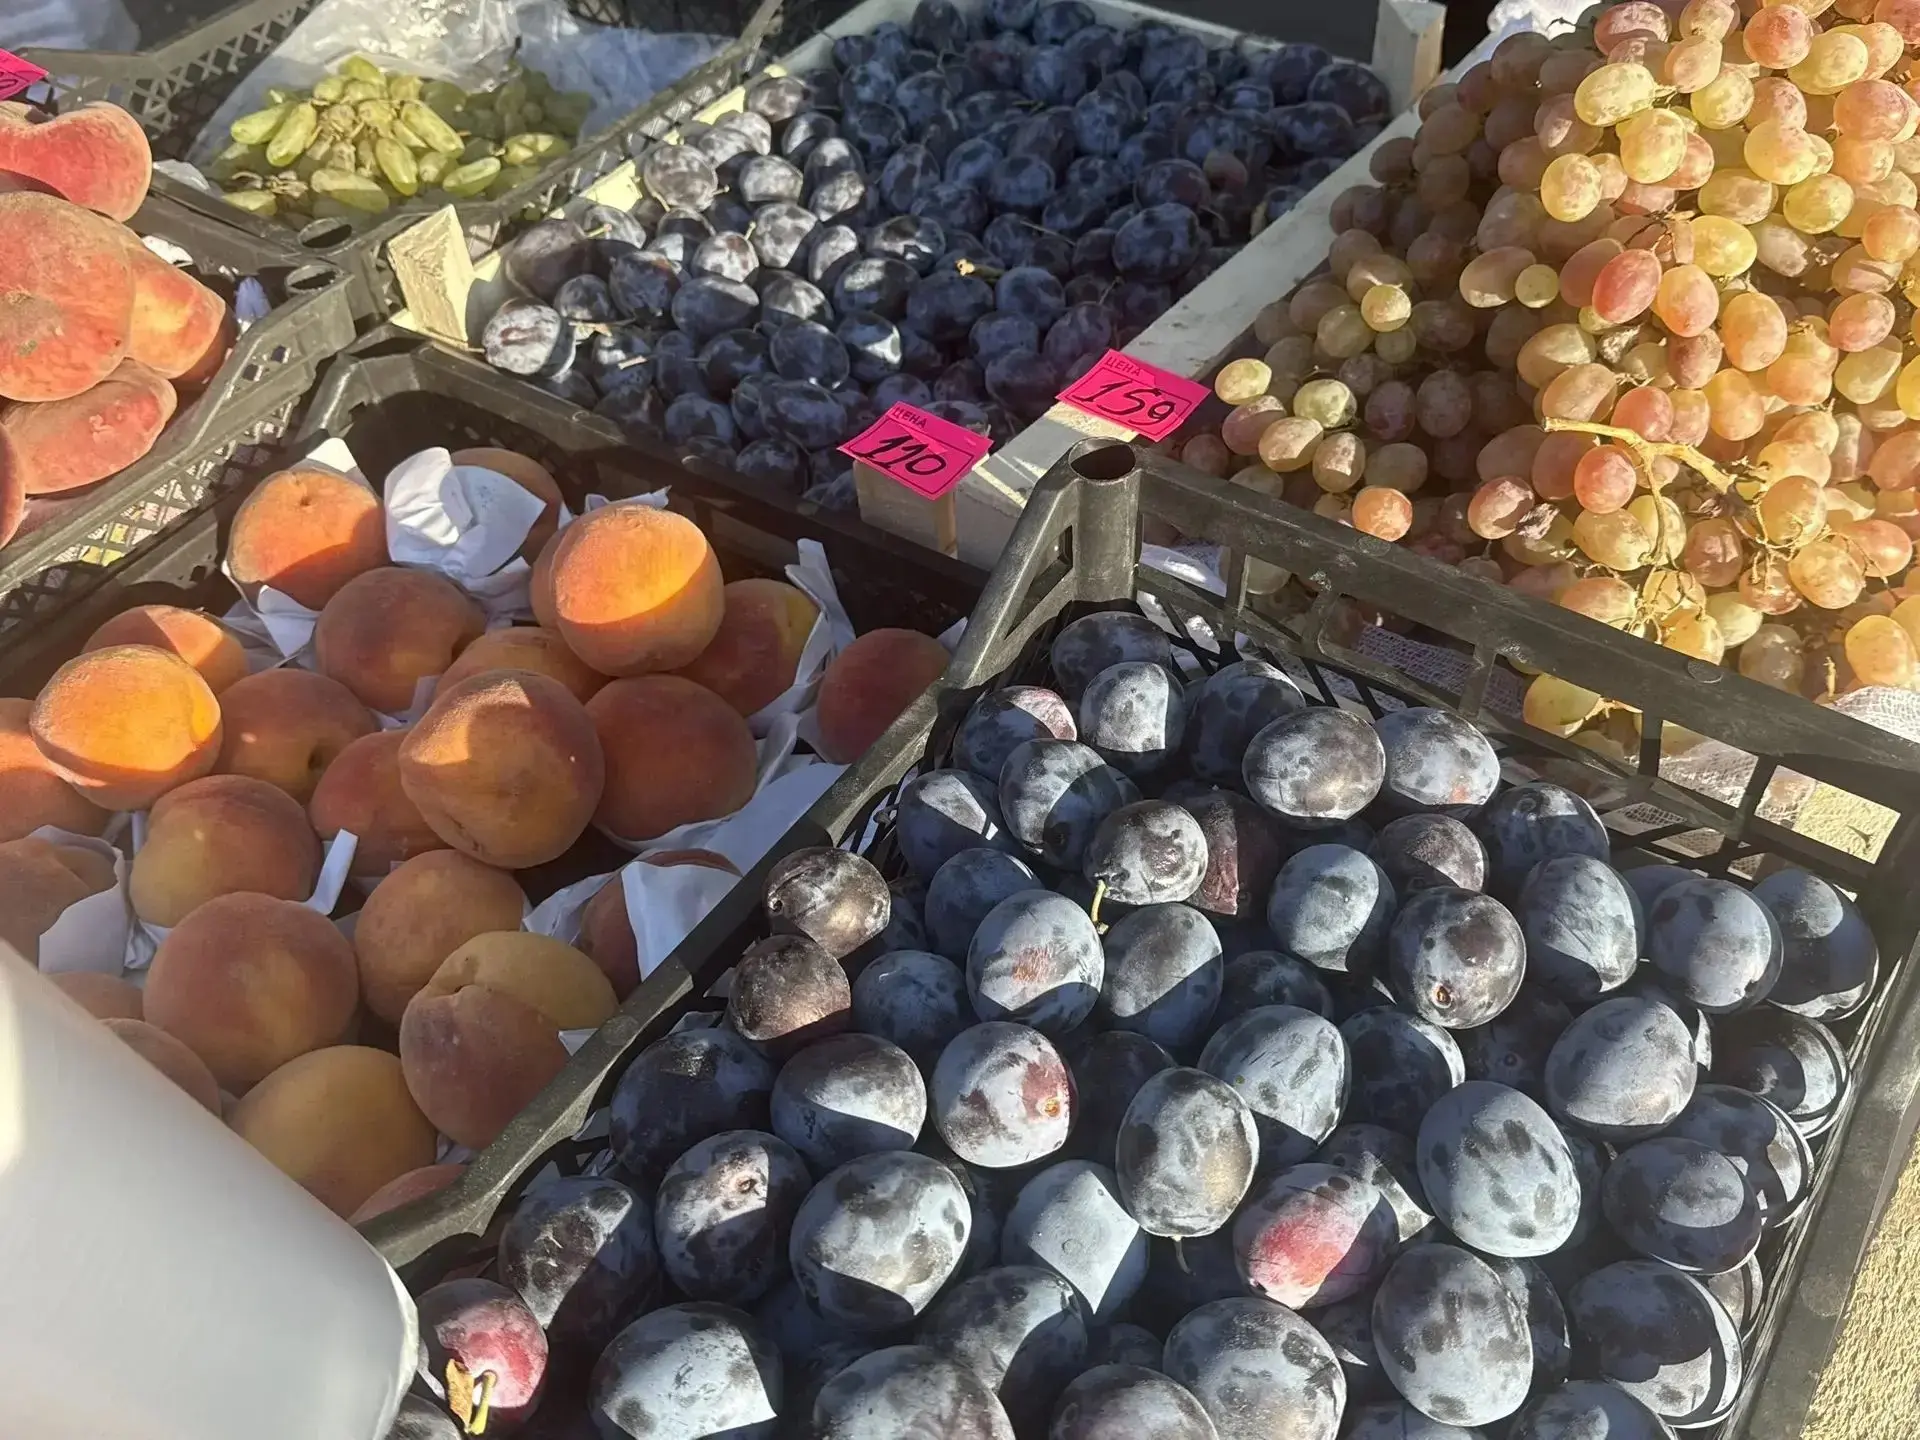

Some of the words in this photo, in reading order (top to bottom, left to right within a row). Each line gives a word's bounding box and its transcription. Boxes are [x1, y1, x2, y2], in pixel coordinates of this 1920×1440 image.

[1104, 357, 1141, 377] ЦЕНА
[892, 407, 927, 428] ЦЕНА
[1072, 380, 1171, 425] 159
[854, 435, 946, 475] 110
